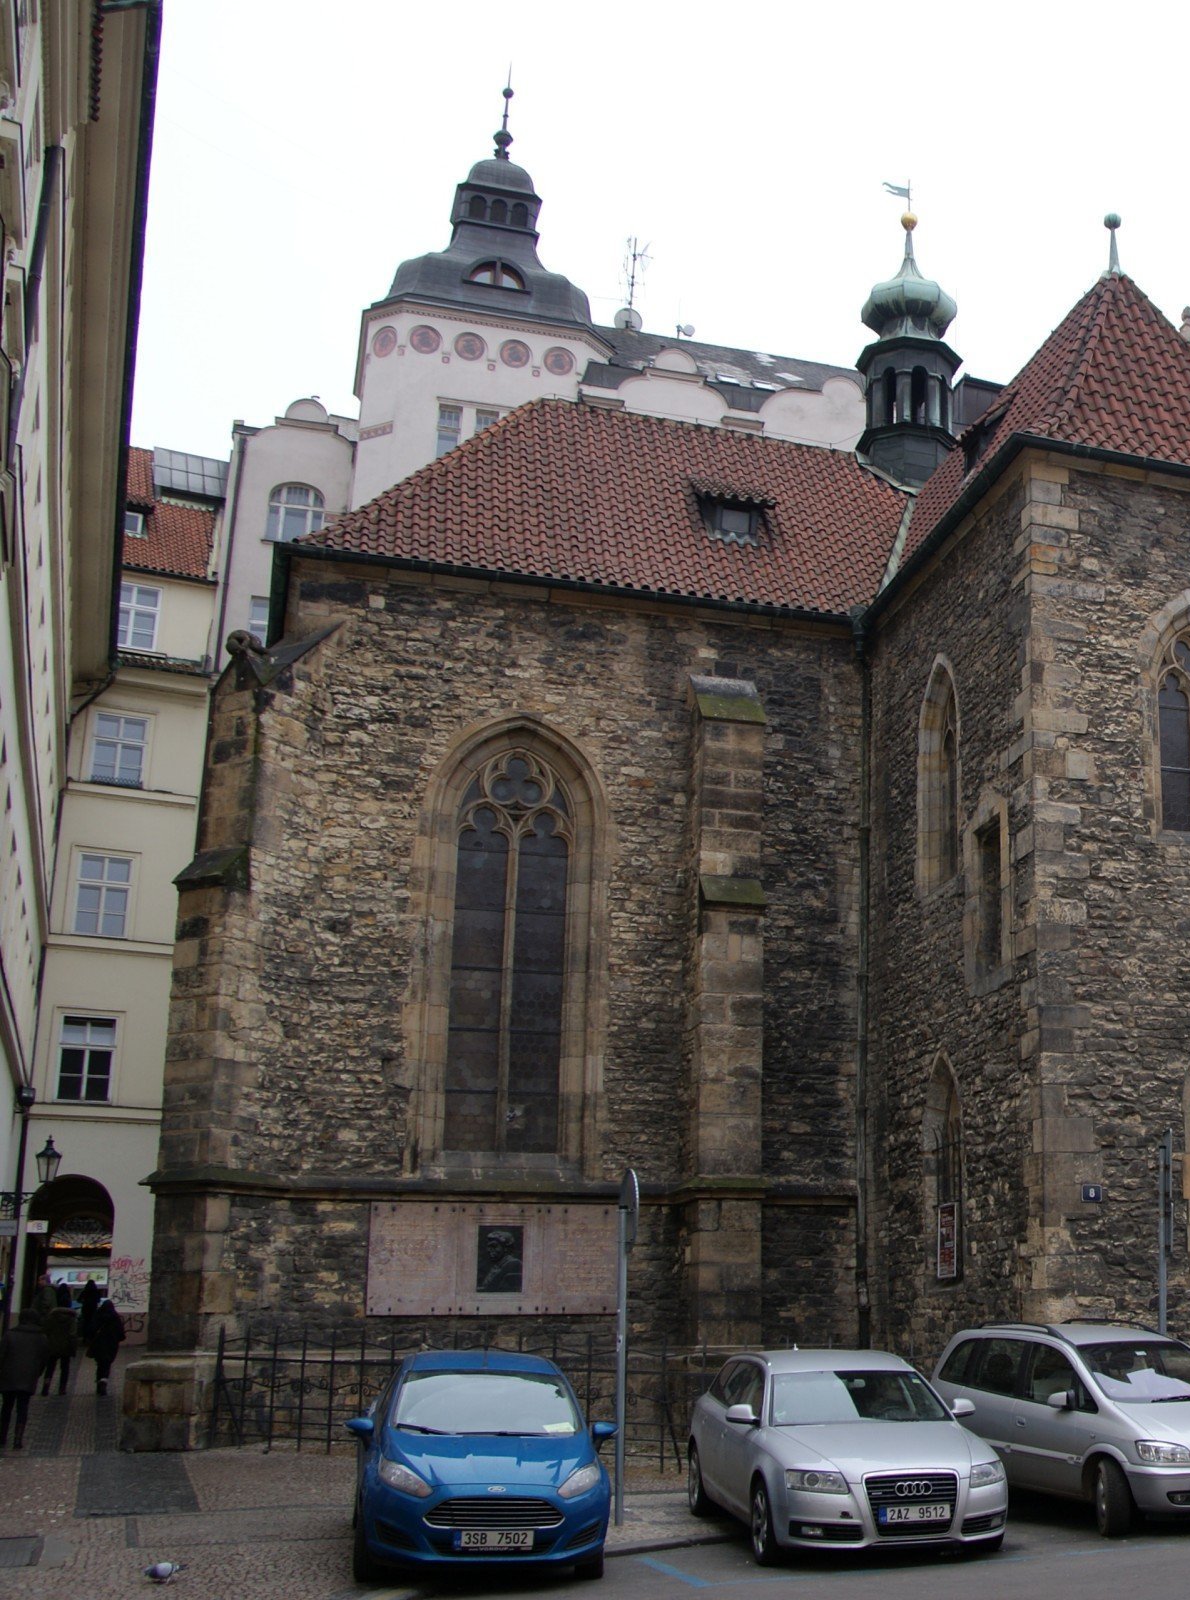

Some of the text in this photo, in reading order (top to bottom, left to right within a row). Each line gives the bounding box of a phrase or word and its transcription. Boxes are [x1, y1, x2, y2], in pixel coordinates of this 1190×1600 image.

[1089, 1188, 1096, 1198] 8
[889, 1506, 945, 1520] 2AZ 9512
[464, 1532, 528, 1545] 3SB 7502
